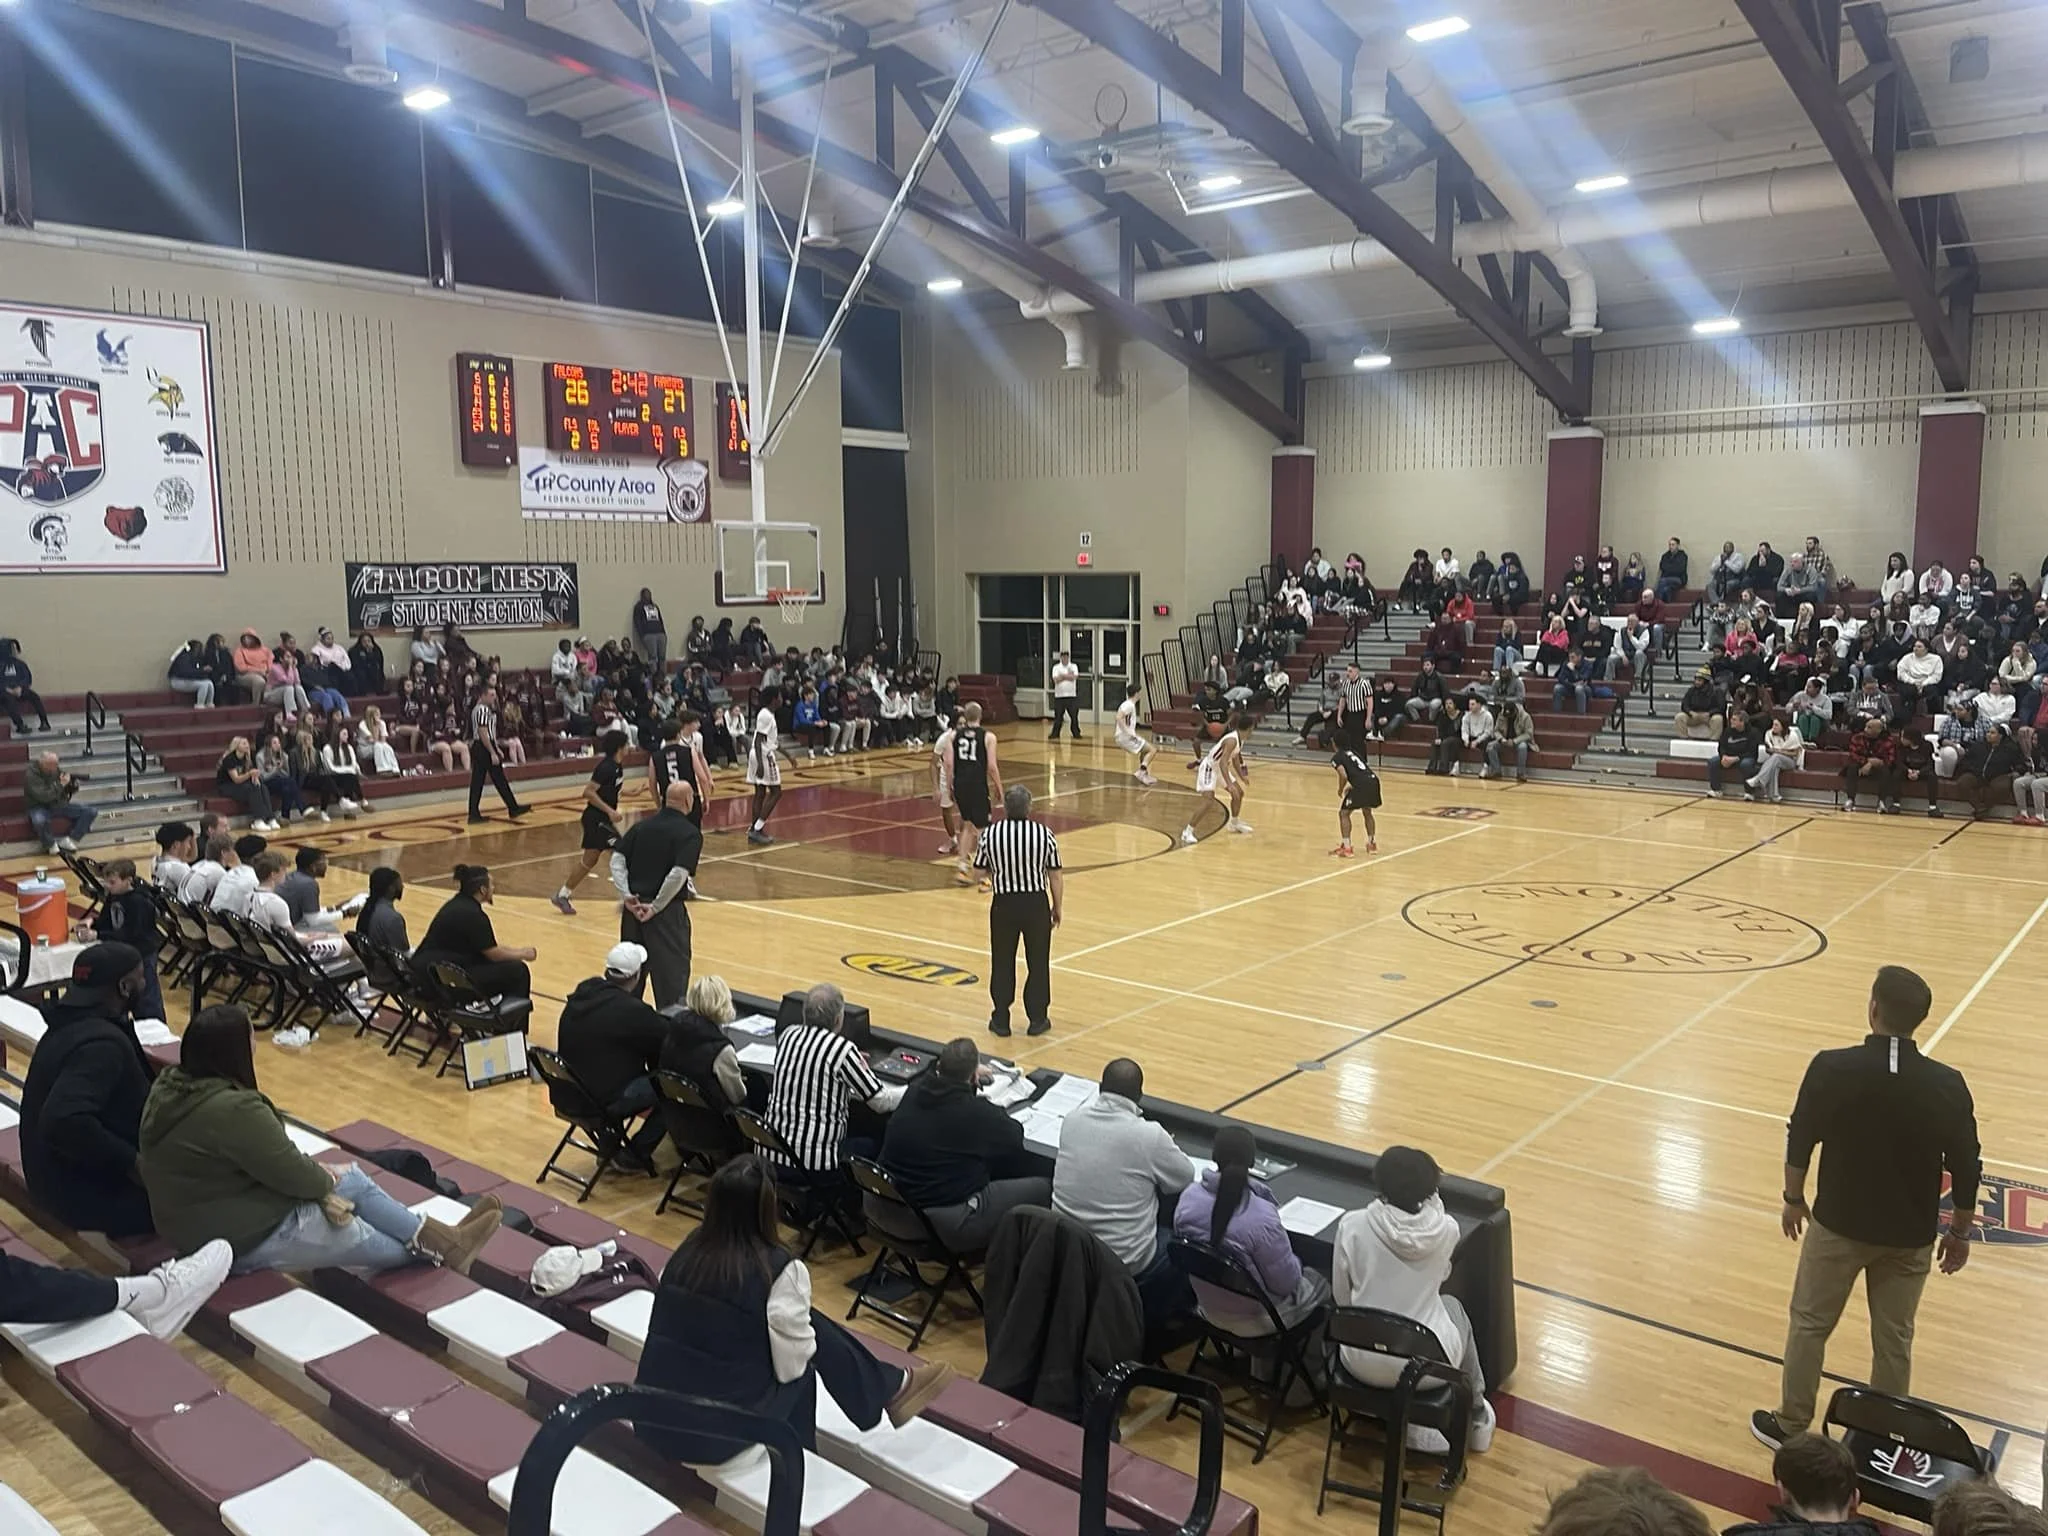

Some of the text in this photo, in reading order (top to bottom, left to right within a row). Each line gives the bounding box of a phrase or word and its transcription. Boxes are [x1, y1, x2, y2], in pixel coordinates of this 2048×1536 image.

[566, 378, 589, 405] 26
[612, 369, 648, 397] 2:42
[664, 388, 685, 413] 27
[641, 404, 651, 422] 2
[614, 421, 639, 436] PLAYER
[571, 430, 581, 450] 2
[619, 477, 655, 494] Area
[543, 495, 645, 506] FEDERAL CREDIT UNION
[362, 564, 564, 594] FALCON NEST
[392, 600, 471, 627] STUDENT
[475, 597, 544, 625] SECTION
[959, 738, 977, 760] 21
[666, 761, 680, 784] 5
